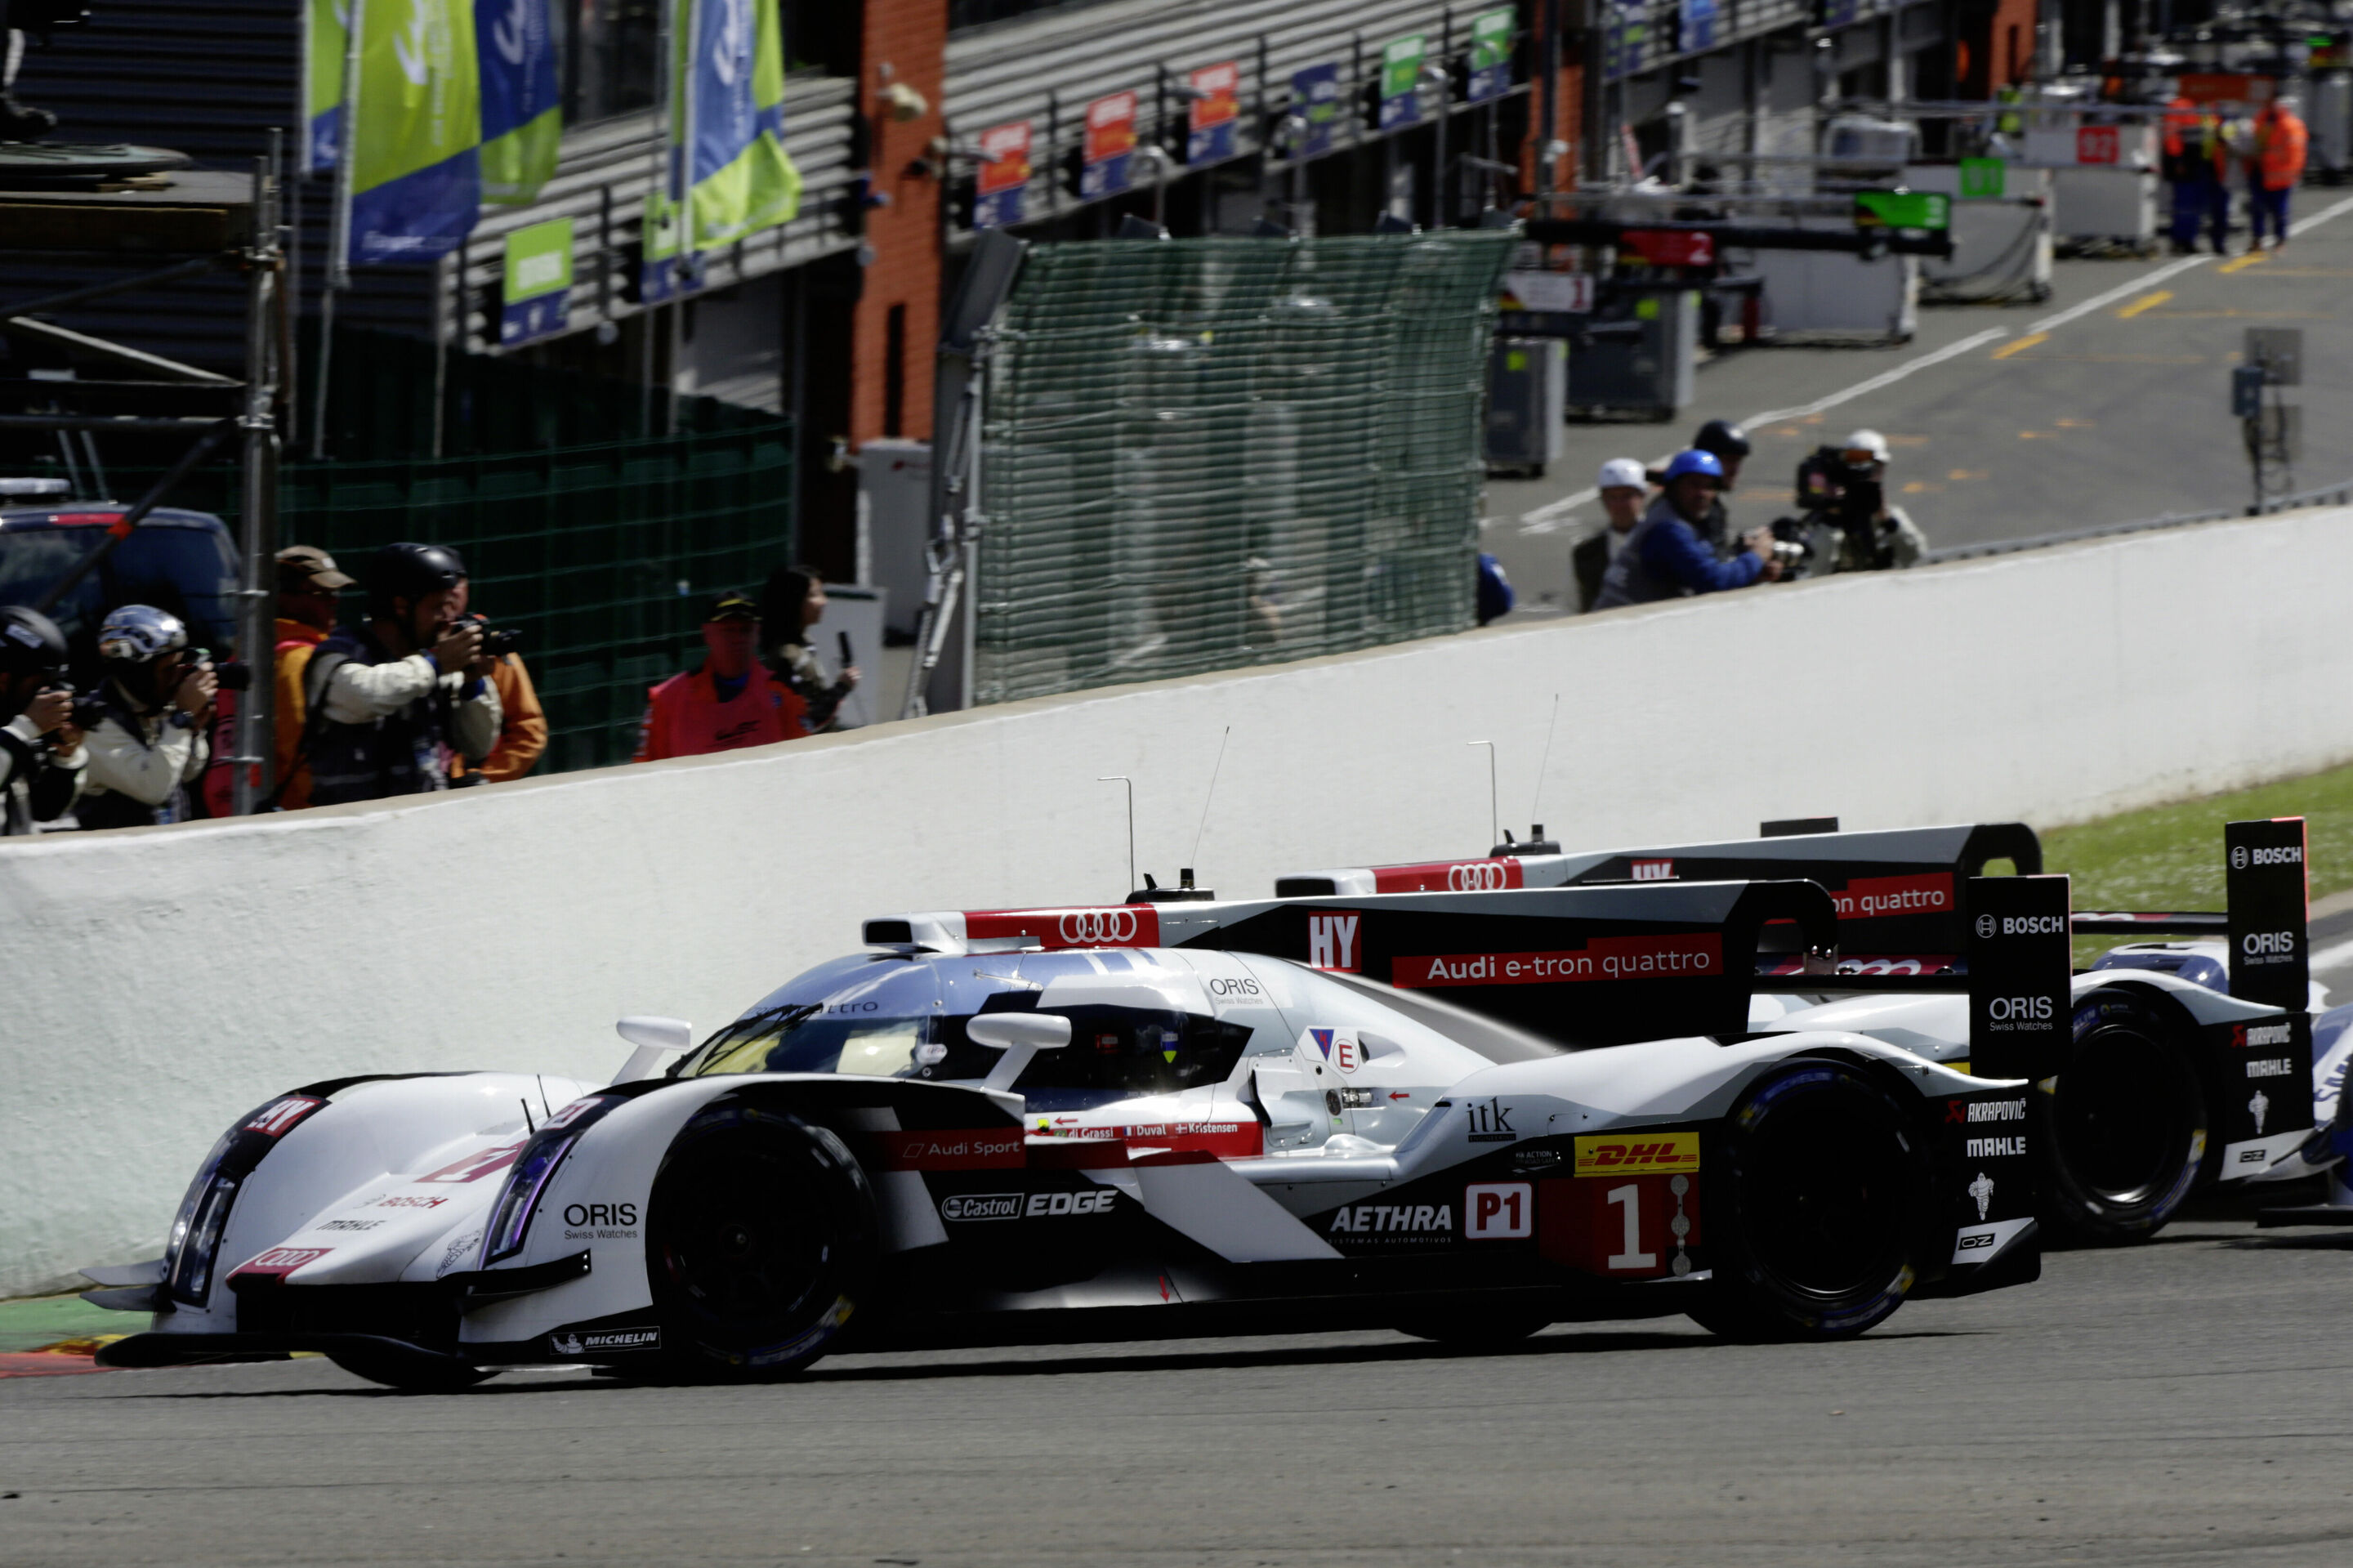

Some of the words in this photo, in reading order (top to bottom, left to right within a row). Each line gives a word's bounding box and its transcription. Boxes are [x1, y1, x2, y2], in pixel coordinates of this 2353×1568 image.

[1689, 232, 1712, 265] 2
[1570, 278, 1587, 310] 1
[2253, 847, 2302, 864] BOSCH
[1860, 890, 1944, 916] quattro
[2003, 916, 2064, 934] BOSCH
[1310, 915, 1357, 968] HY
[2243, 931, 2294, 954] ORIS
[1427, 955, 1495, 979] Audi
[1505, 956, 1593, 977] e-tron
[1602, 950, 1710, 978] quattro
[1210, 979, 1259, 994] ORIS
[1989, 996, 2052, 1020] ORIS
[1989, 1021, 2014, 1031] Swiss
[2016, 1021, 2052, 1031] Watches
[1338, 1043, 1355, 1069] E
[2246, 1058, 2292, 1077] MAHLE
[248, 1100, 315, 1131] HY
[1467, 1096, 1516, 1132] itk
[1068, 1129, 1078, 1138] di
[1081, 1128, 1114, 1138] Grassi
[1136, 1124, 1167, 1136] Duval
[1188, 1123, 1238, 1134] Kristensen
[928, 1143, 967, 1155] Audi
[973, 1141, 1020, 1156] Sport
[1594, 1143, 1681, 1166] DHL
[1967, 1137, 2026, 1157] MAHLE
[377, 1195, 449, 1209] BOSCH
[962, 1198, 1016, 1217] Castrol
[1026, 1190, 1118, 1217] EDGE
[1476, 1191, 1520, 1231] P1
[315, 1220, 387, 1231] MAHLE
[564, 1204, 637, 1226] ORIS
[1329, 1204, 1453, 1232] AETHRA
[564, 1230, 594, 1240] Swiss
[596, 1229, 637, 1239] Watches
[1607, 1184, 1657, 1269] 1
[585, 1332, 658, 1346] MICHELIN
